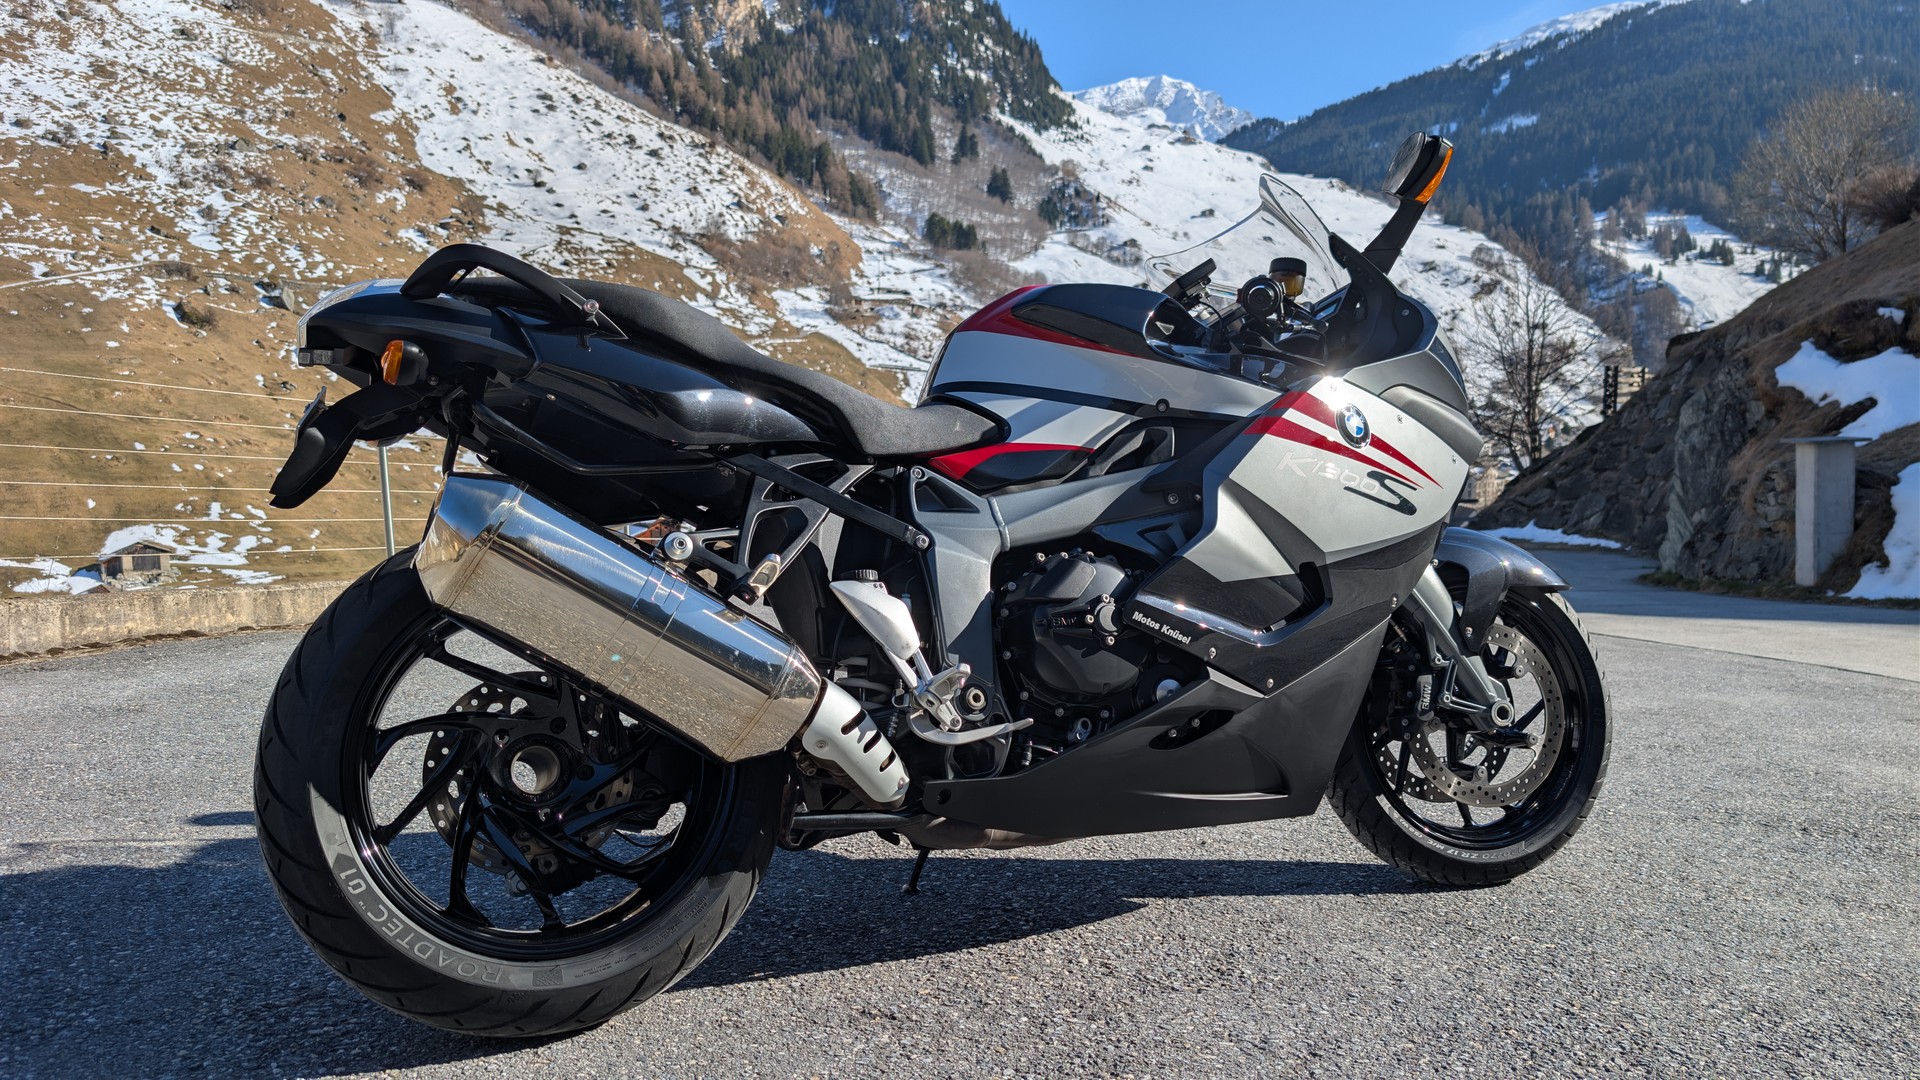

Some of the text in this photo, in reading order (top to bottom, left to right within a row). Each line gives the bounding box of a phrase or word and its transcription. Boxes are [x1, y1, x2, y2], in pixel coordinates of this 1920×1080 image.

[1132, 611, 1191, 645] Motos Knüsel
[1421, 684, 1431, 710] BMW
[1449, 850, 1460, 858] 17
[337, 867, 367, 895] 01
